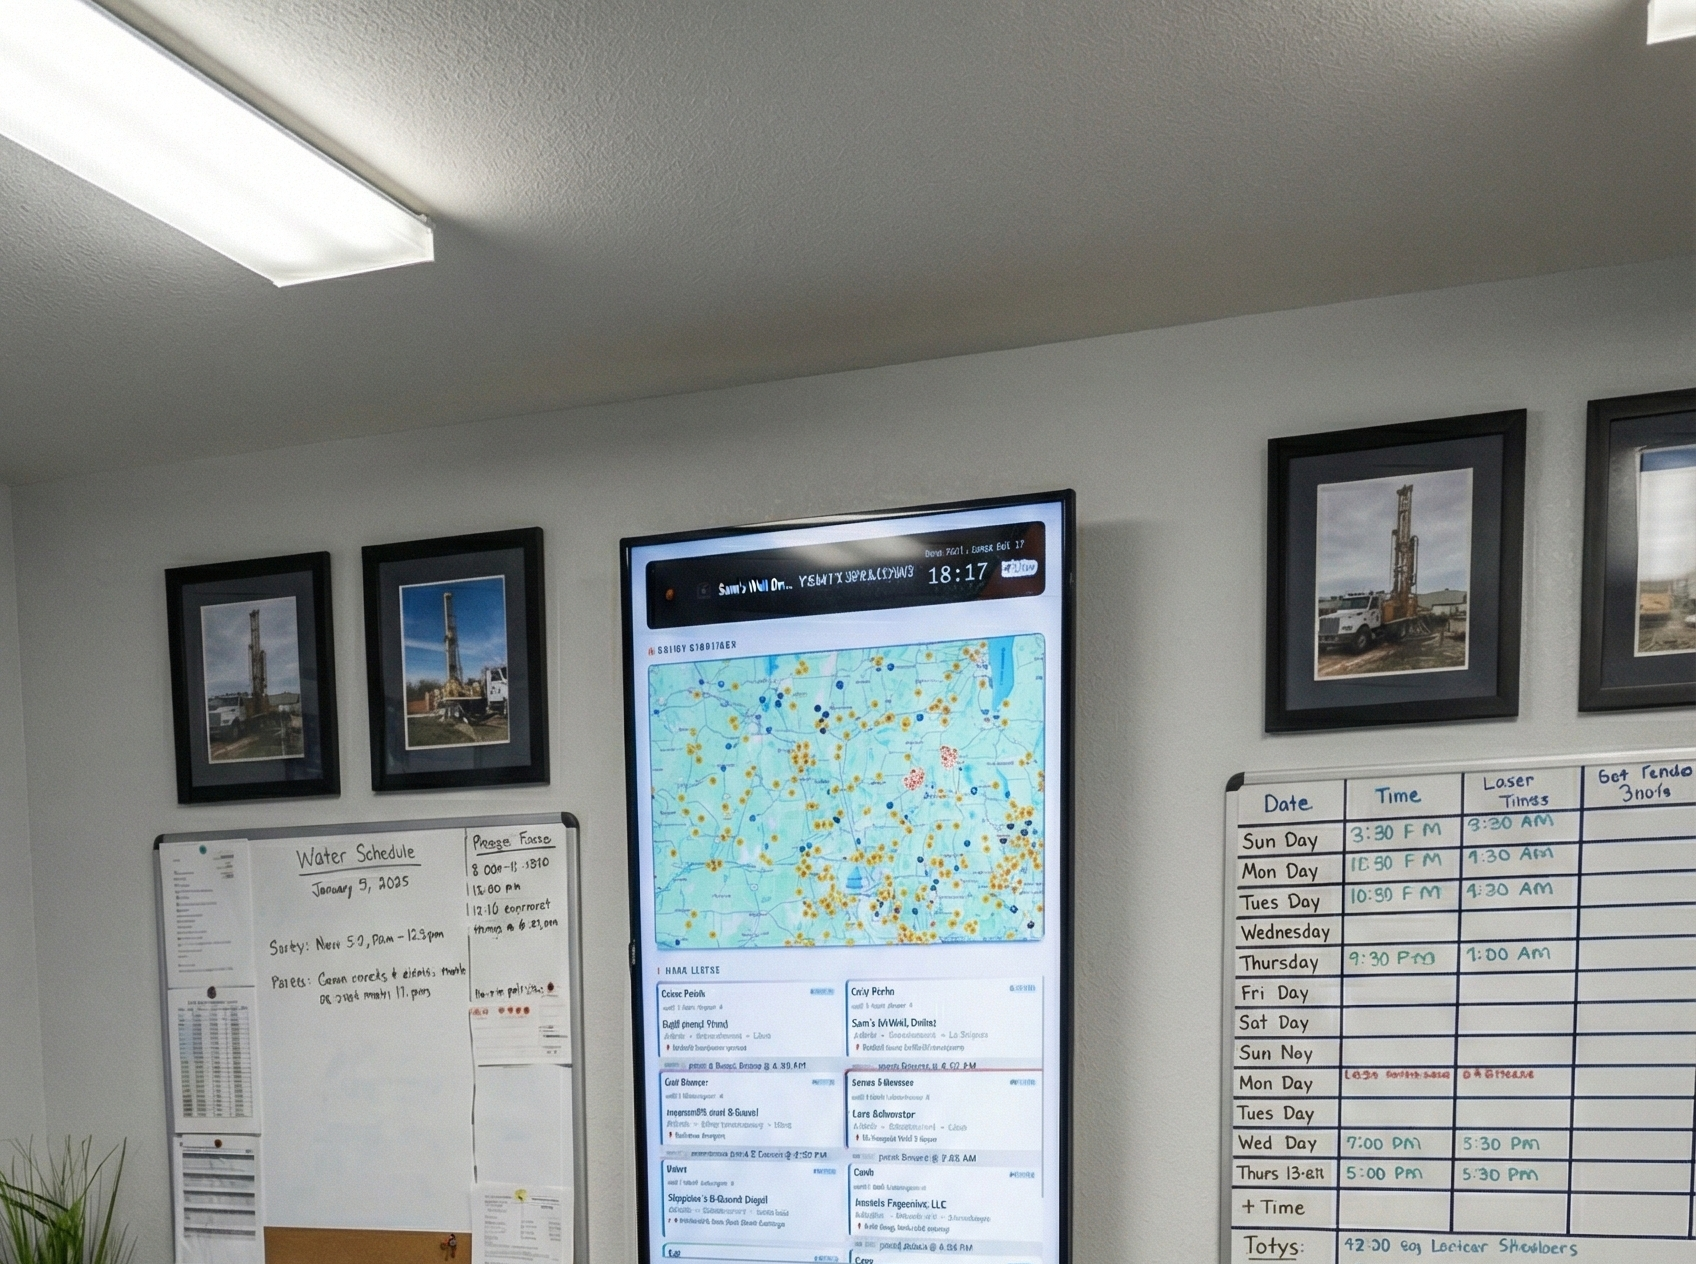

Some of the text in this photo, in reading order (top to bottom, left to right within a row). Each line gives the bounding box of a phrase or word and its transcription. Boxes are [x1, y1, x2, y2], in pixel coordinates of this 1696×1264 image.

[928, 562, 988, 585] 18:17
[1264, 794, 1313, 814] Date
[1374, 786, 1422, 806] Time
[1423, 822, 1442, 837] M
[1521, 814, 1555, 828] AM
[1242, 830, 1319, 852] Sun Day
[296, 843, 415, 868] Water Schedule
[1423, 852, 1442, 867] M
[1242, 862, 1319, 883] Mon Day
[1420, 885, 1441, 900] M
[1519, 882, 1553, 896] AM
[1240, 892, 1320, 913] Tues Day
[1241, 924, 1330, 943] Wednesday
[1239, 954, 1319, 973] Thursday
[1242, 985, 1309, 1004] Fri Day
[1239, 1014, 1309, 1033] Sat Day
[1239, 1044, 1271, 1060] Sun
[1240, 1075, 1313, 1094] Mon Day
[1237, 1105, 1314, 1125] Tues Day
[1238, 1135, 1317, 1153] Wed Day
[1346, 1136, 1384, 1151] 7:00
[963, 1154, 977, 1163] AM
[1236, 1165, 1278, 1180] Thurs
[1346, 1165, 1386, 1181] 5:00
[1462, 1166, 1501, 1182] 5:30
[1260, 1199, 1305, 1215] Time
